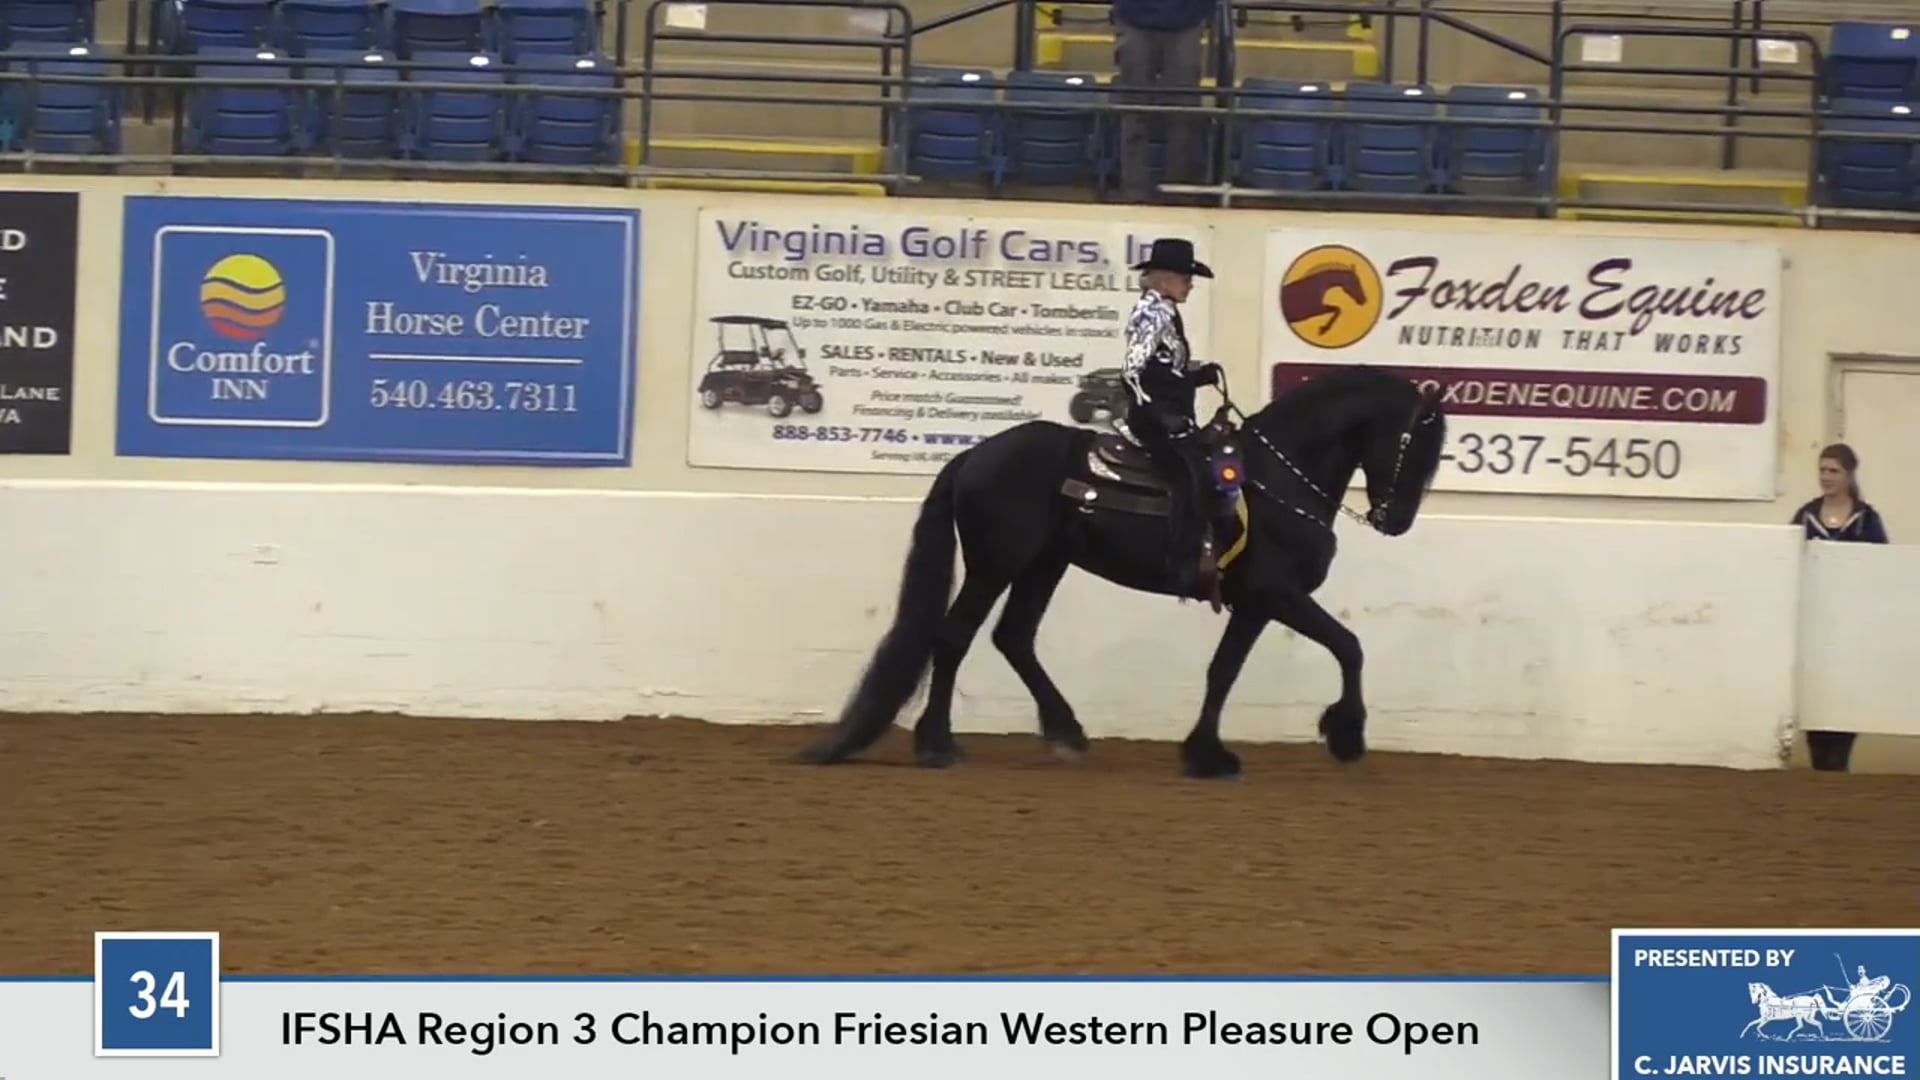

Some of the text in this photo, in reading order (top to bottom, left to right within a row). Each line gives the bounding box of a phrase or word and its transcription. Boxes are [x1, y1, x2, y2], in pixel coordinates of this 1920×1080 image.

[715, 219, 886, 261] Virginia
[901, 226, 988, 259] Golf
[1126, 233, 1153, 264] In
[408, 251, 549, 293] Virginia
[727, 261, 1142, 292] Custom Golf, Utility & STREET LEGAL L
[792, 295, 847, 311] EZ-GO
[861, 298, 930, 314] Yamaha
[944, 300, 985, 316] Club
[988, 302, 1018, 317] Car
[1386, 256, 1767, 336] Foxden Equine
[365, 302, 590, 339] Horse Center
[820, 344, 1084, 368] SALES RENTALS New & Used
[1398, 325, 1743, 355] NUTRITION THAT WORKS
[167, 341, 315, 374] Comfort
[209, 378, 269, 400] INN
[370, 379, 578, 413] 540.463.7311
[773, 425, 907, 443] 888-853-7746
